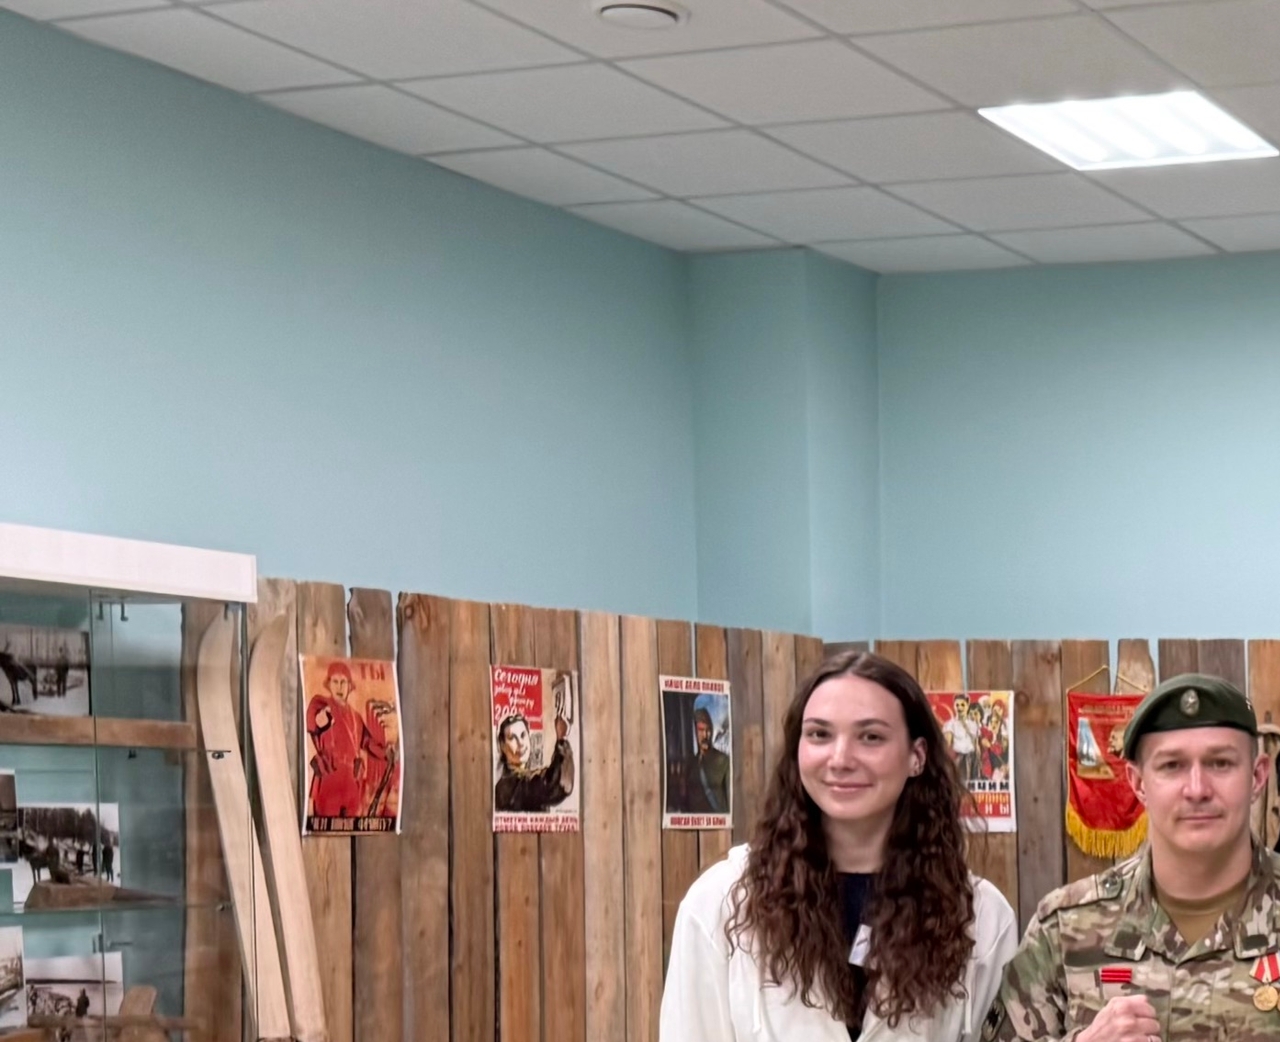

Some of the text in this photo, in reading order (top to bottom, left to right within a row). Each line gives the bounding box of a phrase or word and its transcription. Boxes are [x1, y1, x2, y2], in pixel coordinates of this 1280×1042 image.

[360, 661, 387, 681] ТЫ
[494, 668, 539, 690] Сегодня
[967, 781, 1009, 791] ИЧИМ
